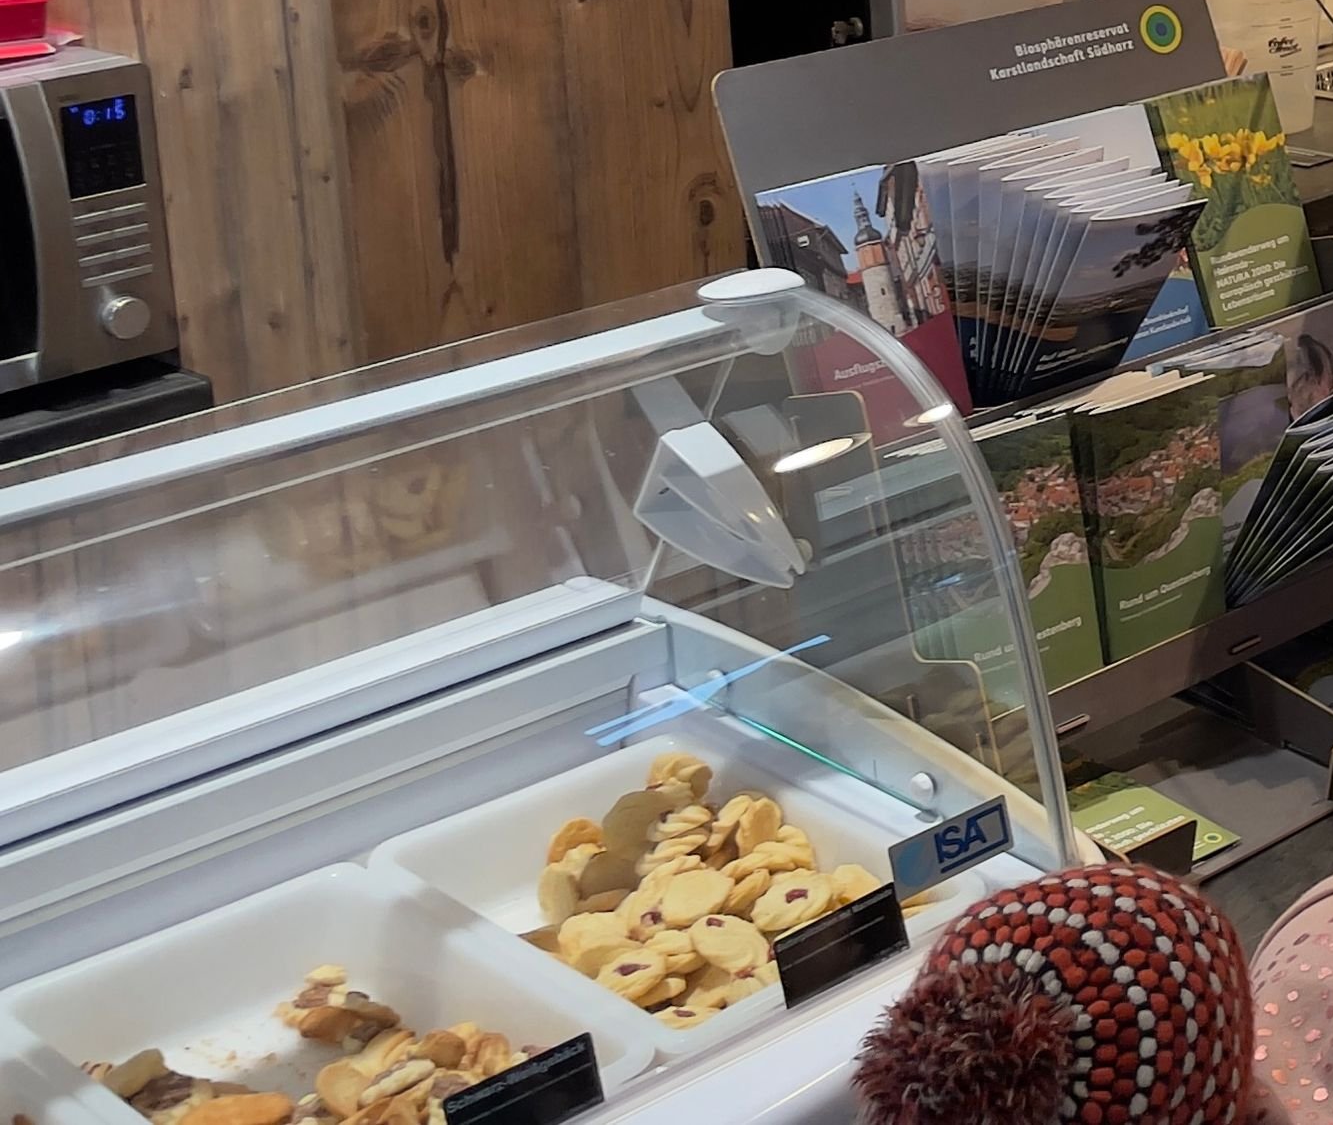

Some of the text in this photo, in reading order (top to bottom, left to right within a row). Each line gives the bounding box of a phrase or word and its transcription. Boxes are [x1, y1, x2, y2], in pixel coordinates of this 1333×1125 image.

[989, 39, 1135, 81] Karstlandschaft Südharz
[1014, 22, 1130, 57] Biosphärenreservat
[934, 814, 987, 864] ISA
